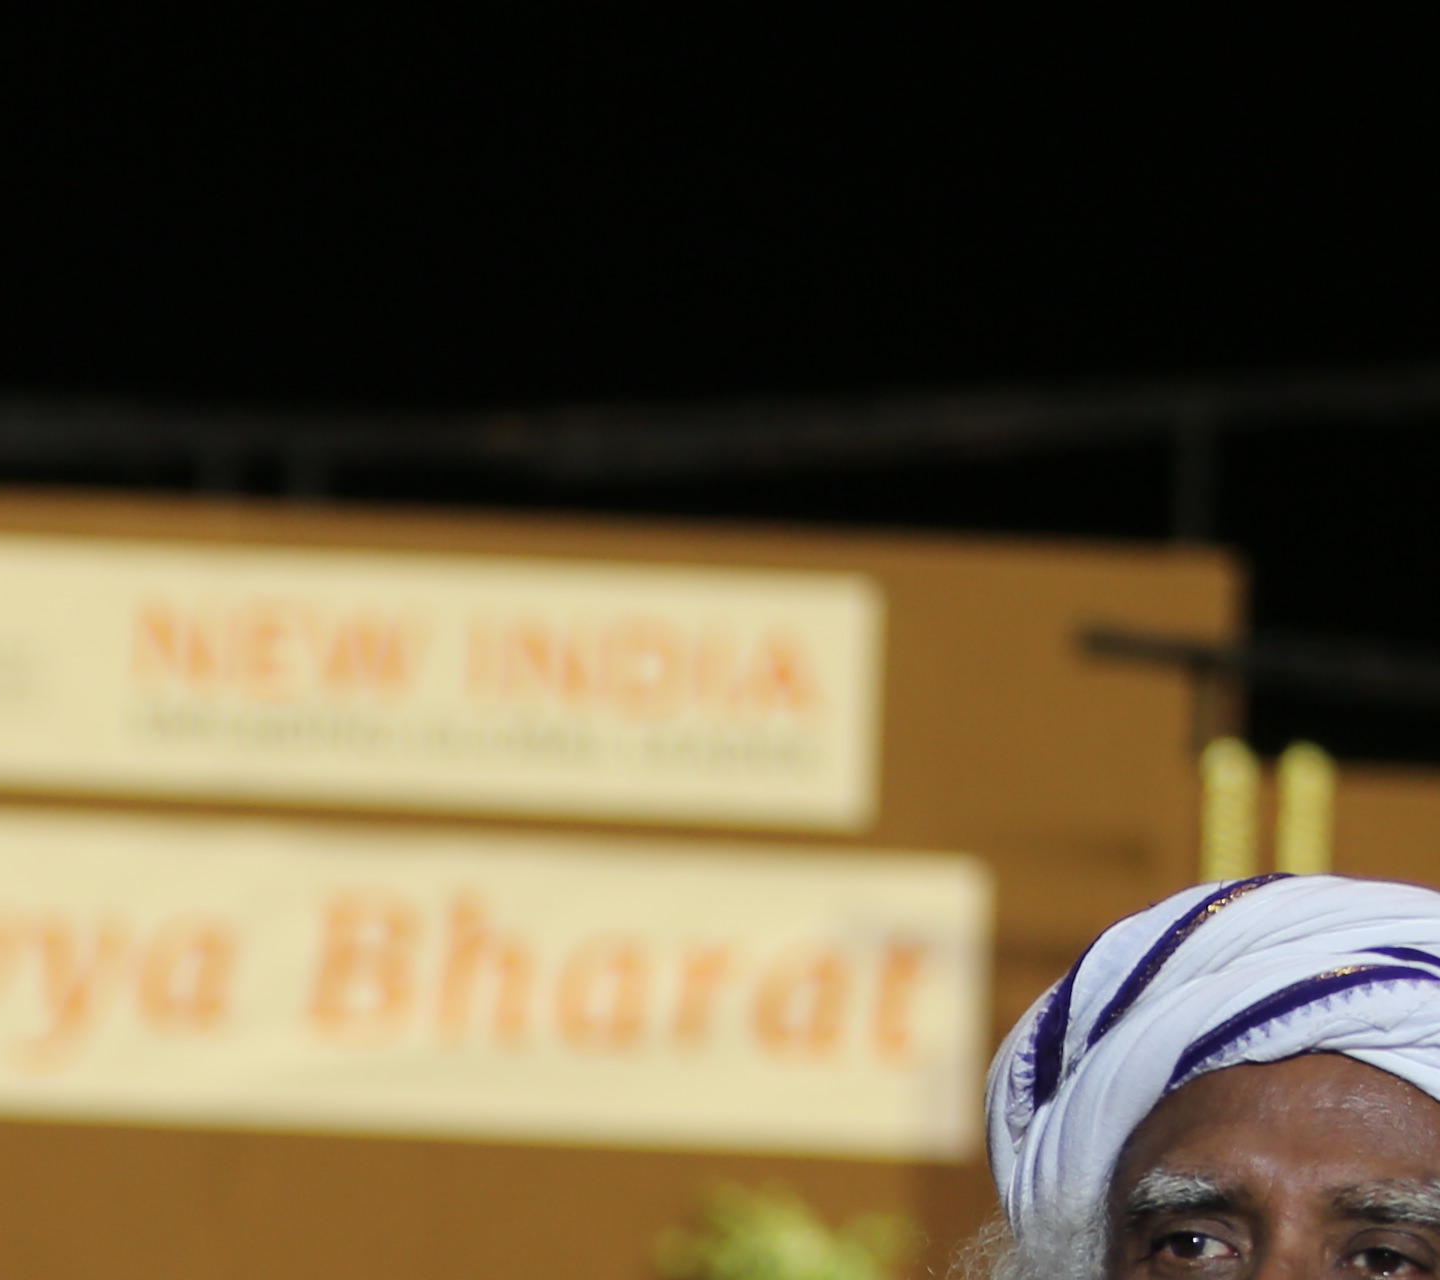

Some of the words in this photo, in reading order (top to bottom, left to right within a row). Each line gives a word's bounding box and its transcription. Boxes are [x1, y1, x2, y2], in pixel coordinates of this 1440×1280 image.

[132, 593, 425, 708] NEW
[464, 608, 822, 724] INDIA
[306, 884, 942, 1066] Bharat
